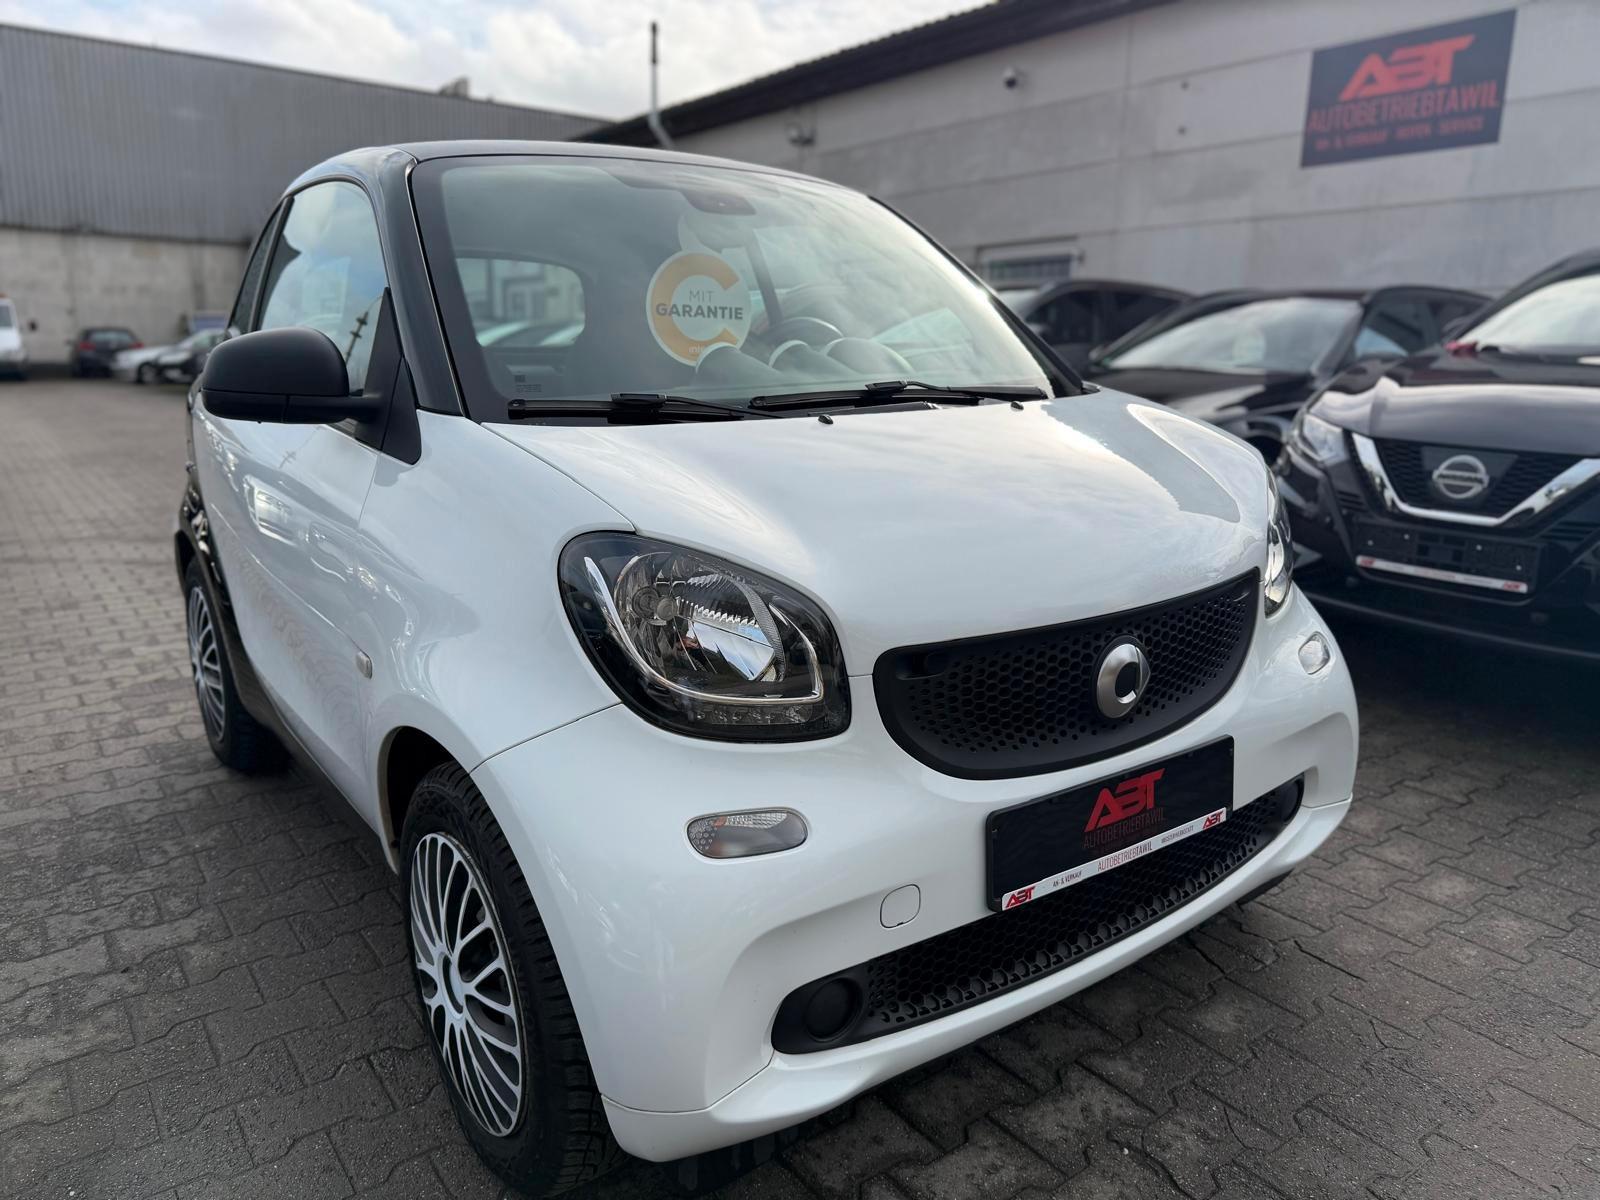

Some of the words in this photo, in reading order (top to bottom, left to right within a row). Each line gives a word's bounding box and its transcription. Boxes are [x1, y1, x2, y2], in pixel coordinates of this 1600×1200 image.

[1339, 34, 1476, 101] ABT
[655, 303, 744, 320] GARANTIE
[688, 289, 715, 302] MIT
[1084, 768, 1166, 833] ABT
[1083, 807, 1167, 849] AUTOBETRIEBTAWIL
[1005, 885, 1036, 909] ABT
[1097, 841, 1153, 872] AUTOBETRIEBTAWIL
[1202, 810, 1225, 829] ABT
